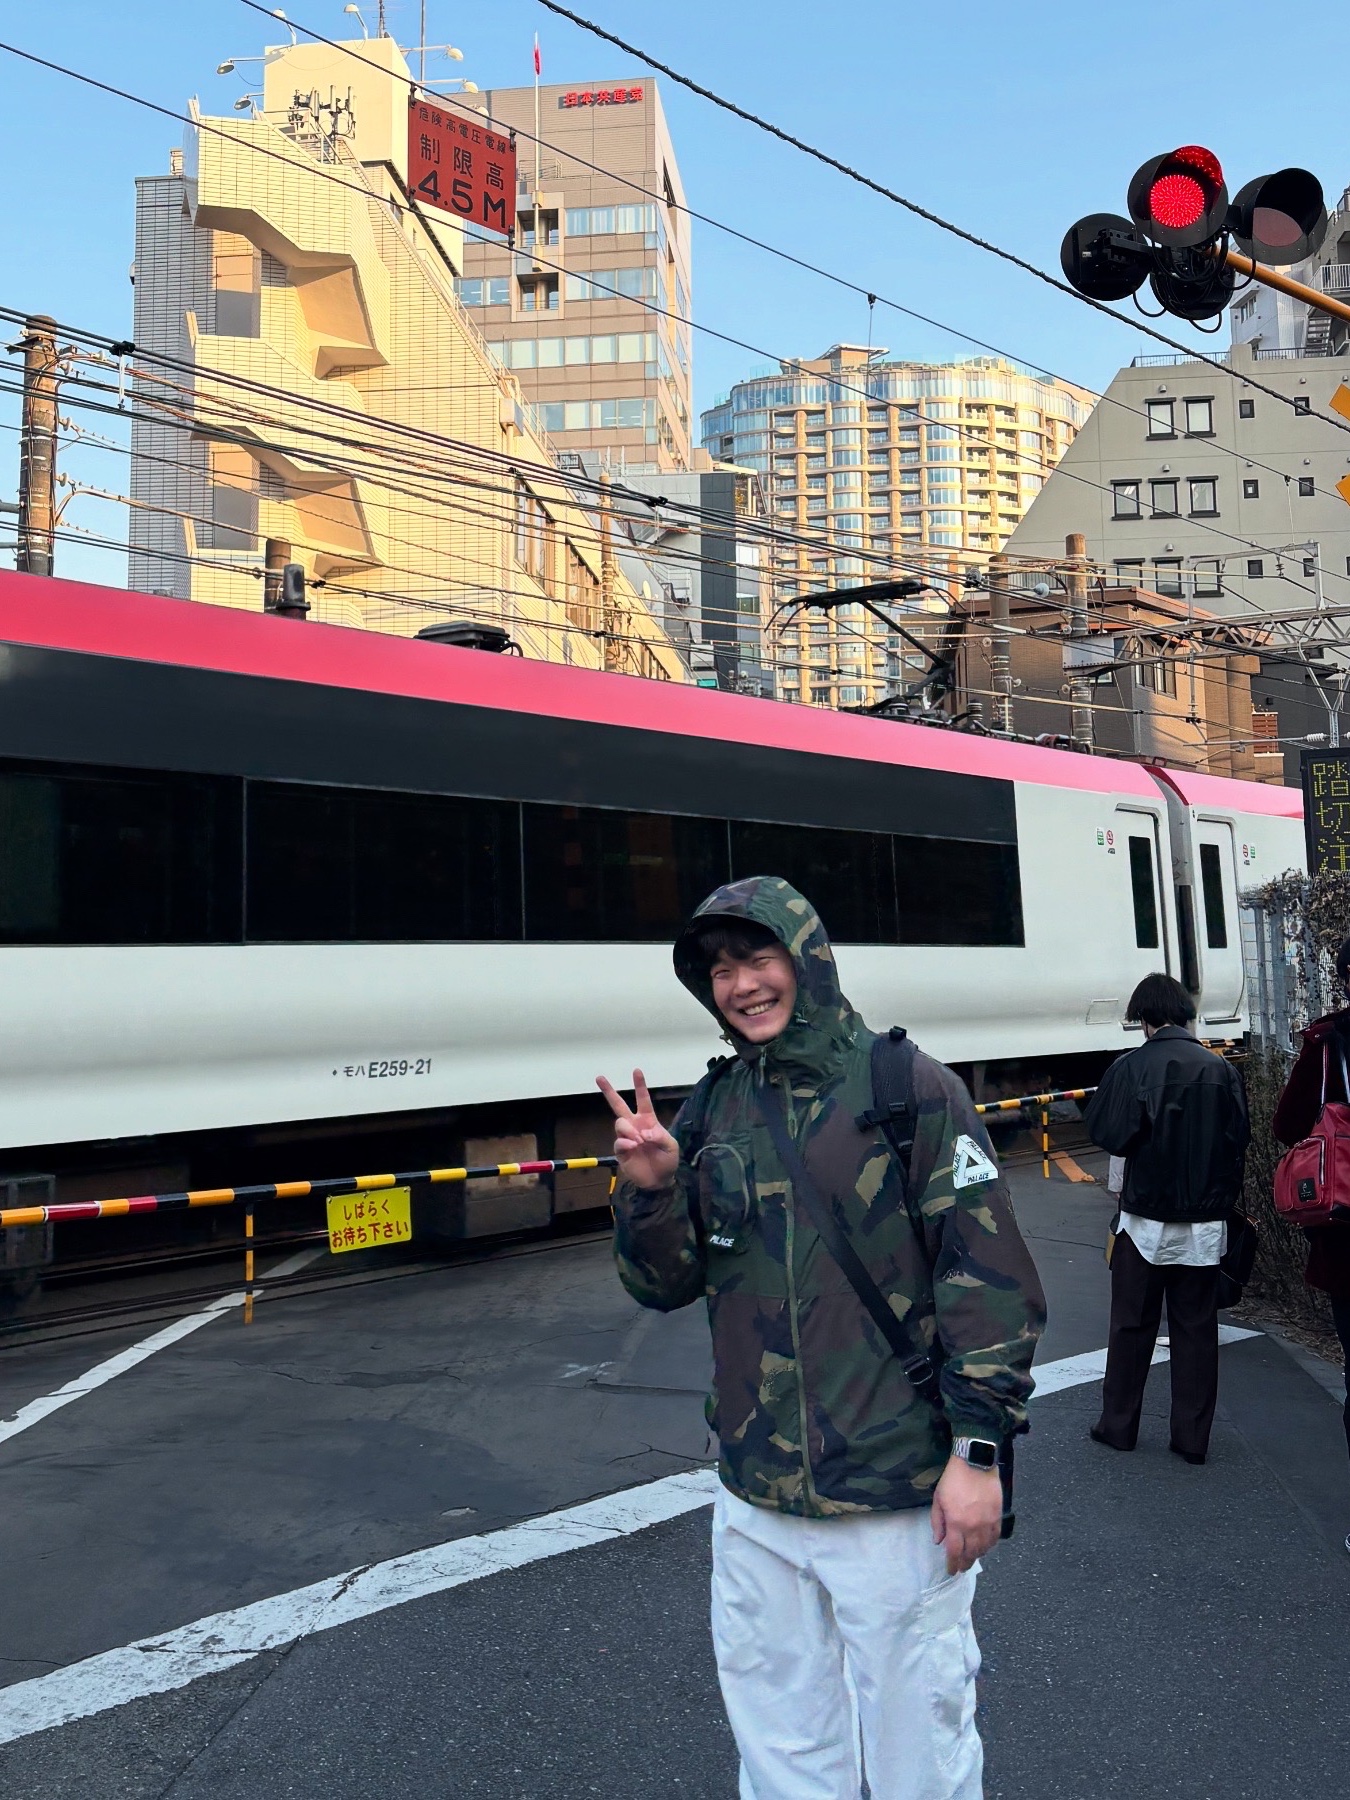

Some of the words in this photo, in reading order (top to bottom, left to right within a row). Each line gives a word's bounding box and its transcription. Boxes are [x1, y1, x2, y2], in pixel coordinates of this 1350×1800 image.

[564, 86, 644, 107] 日本共産党
[419, 107, 506, 154] 危険高電圧電線
[420, 133, 504, 191] 制限高
[418, 169, 506, 229] 4.5M
[967, 1172, 989, 1184] PALACE
[343, 1199, 390, 1220] しばらく
[331, 1220, 409, 1248] お待ち下さい
